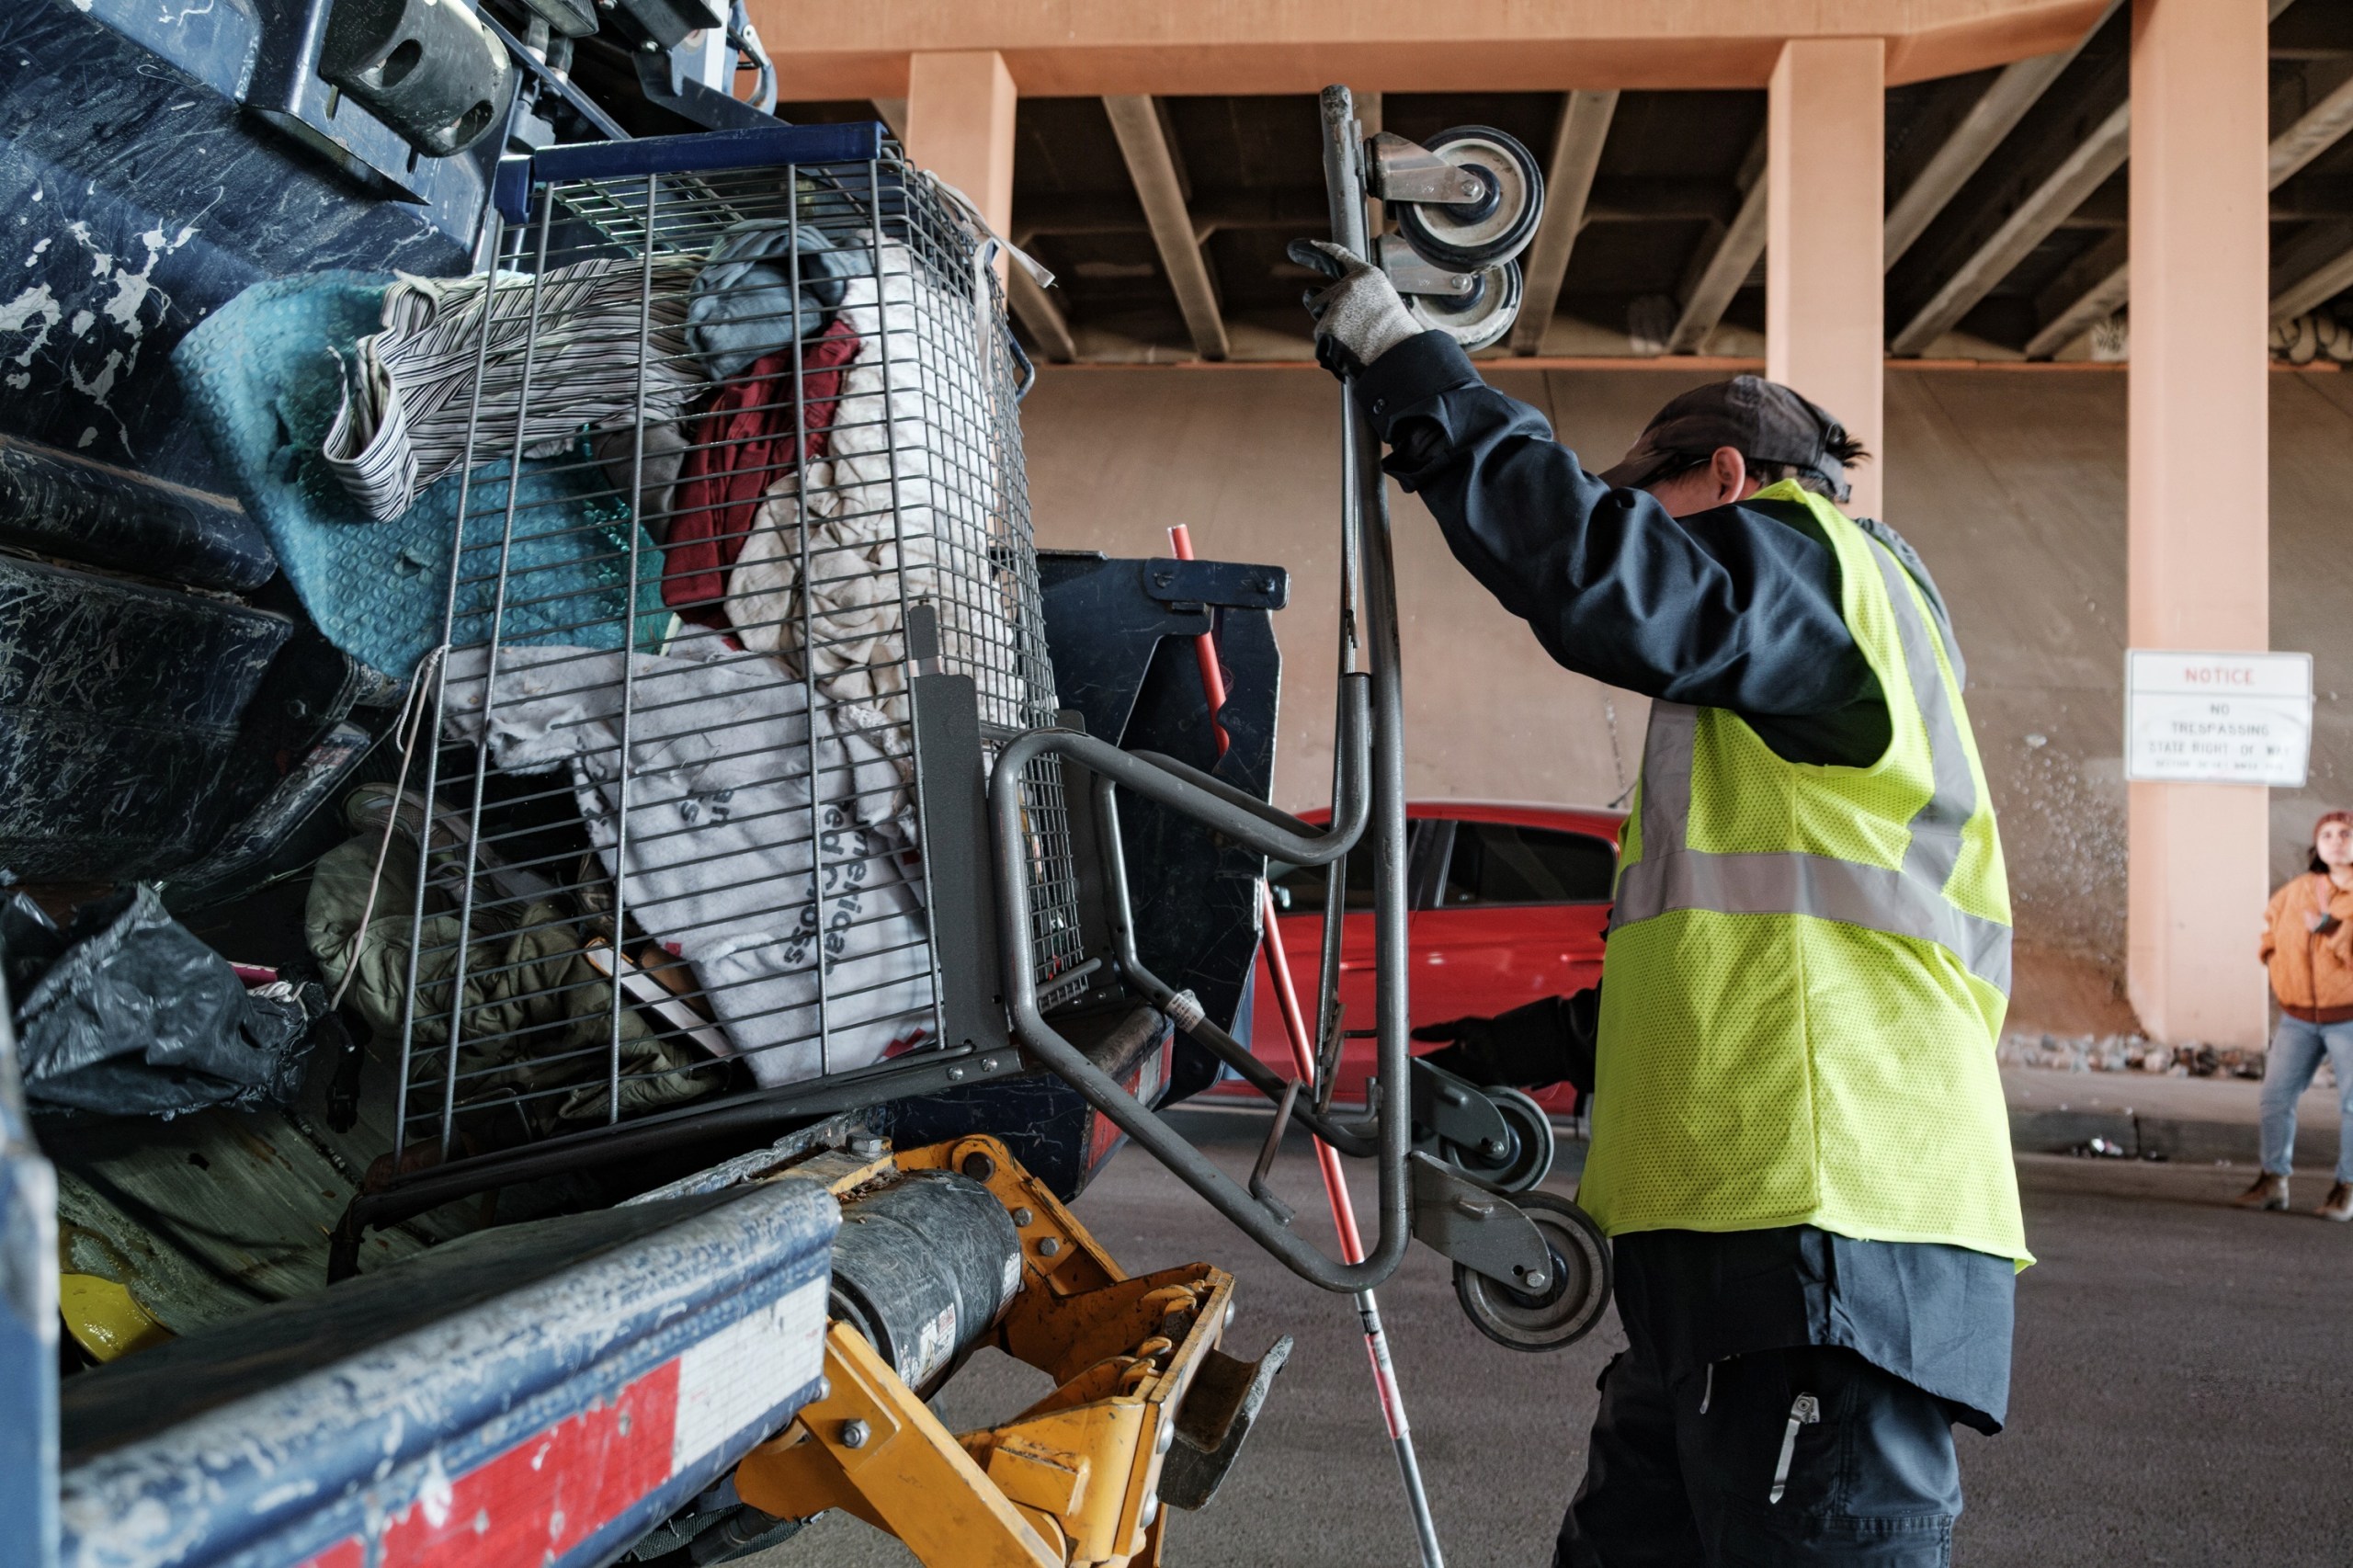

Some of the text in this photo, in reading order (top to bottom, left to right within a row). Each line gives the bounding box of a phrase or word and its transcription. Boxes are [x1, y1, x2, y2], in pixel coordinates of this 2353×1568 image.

[2184, 667, 2255, 686] NOTICE
[2210, 703, 2231, 715] NO
[2171, 722, 2270, 737] TRESPASSING
[2148, 741, 2184, 754] STATE
[2191, 743, 2228, 755] RIGHT
[819, 802, 849, 856] ed
[825, 824, 870, 976] merican
